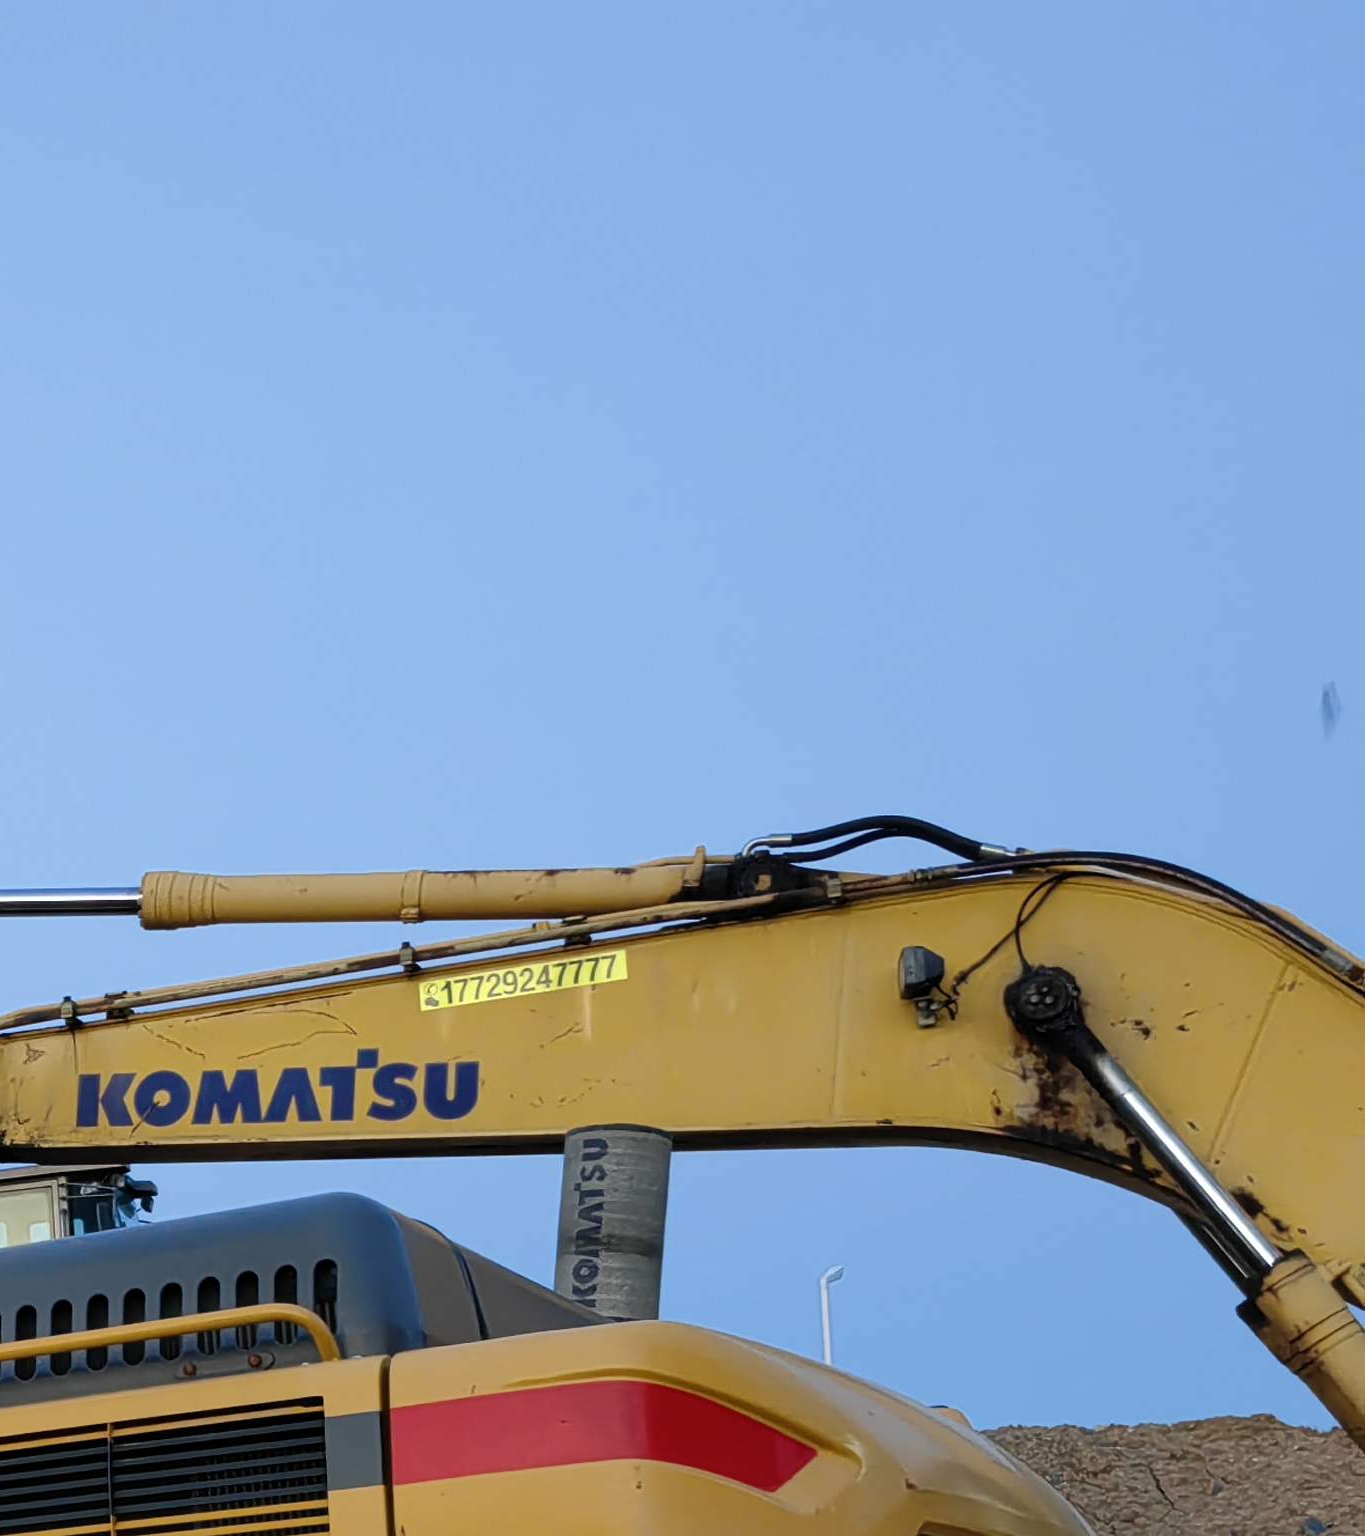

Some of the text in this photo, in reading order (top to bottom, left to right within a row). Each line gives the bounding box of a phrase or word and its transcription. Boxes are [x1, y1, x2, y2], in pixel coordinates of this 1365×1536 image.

[440, 953, 617, 1005] 17729247777
[76, 1047, 480, 1127] KOMATSU
[571, 1137, 610, 1309] KOMATSU
